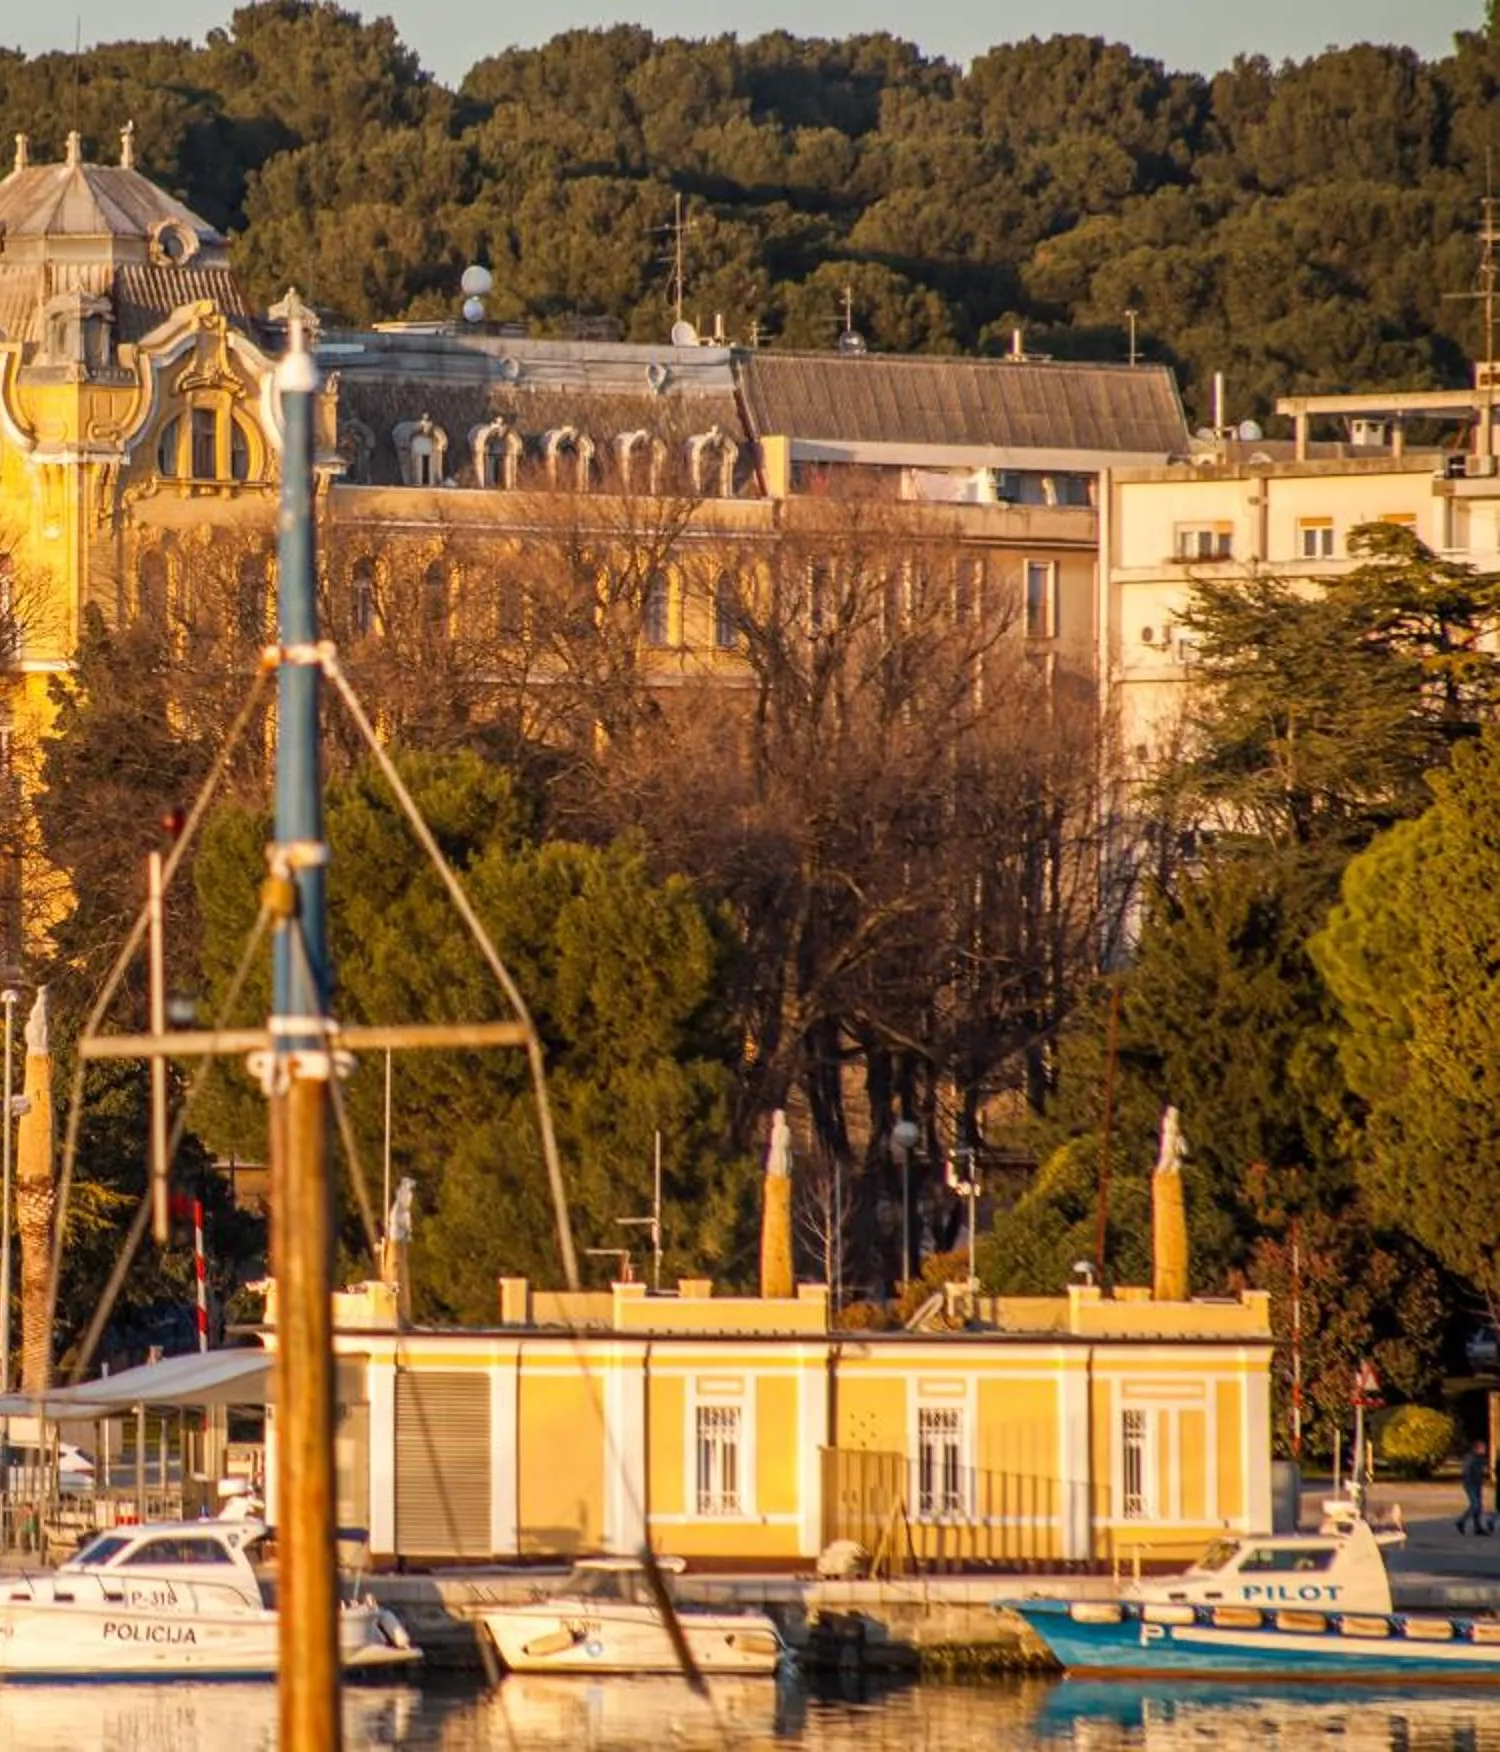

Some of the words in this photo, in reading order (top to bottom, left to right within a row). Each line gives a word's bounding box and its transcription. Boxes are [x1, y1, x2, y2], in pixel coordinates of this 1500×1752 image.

[1242, 1585, 1344, 1601] PILOT
[103, 1621, 197, 1644] POLICIJA
[1140, 1624, 1165, 1647] P
